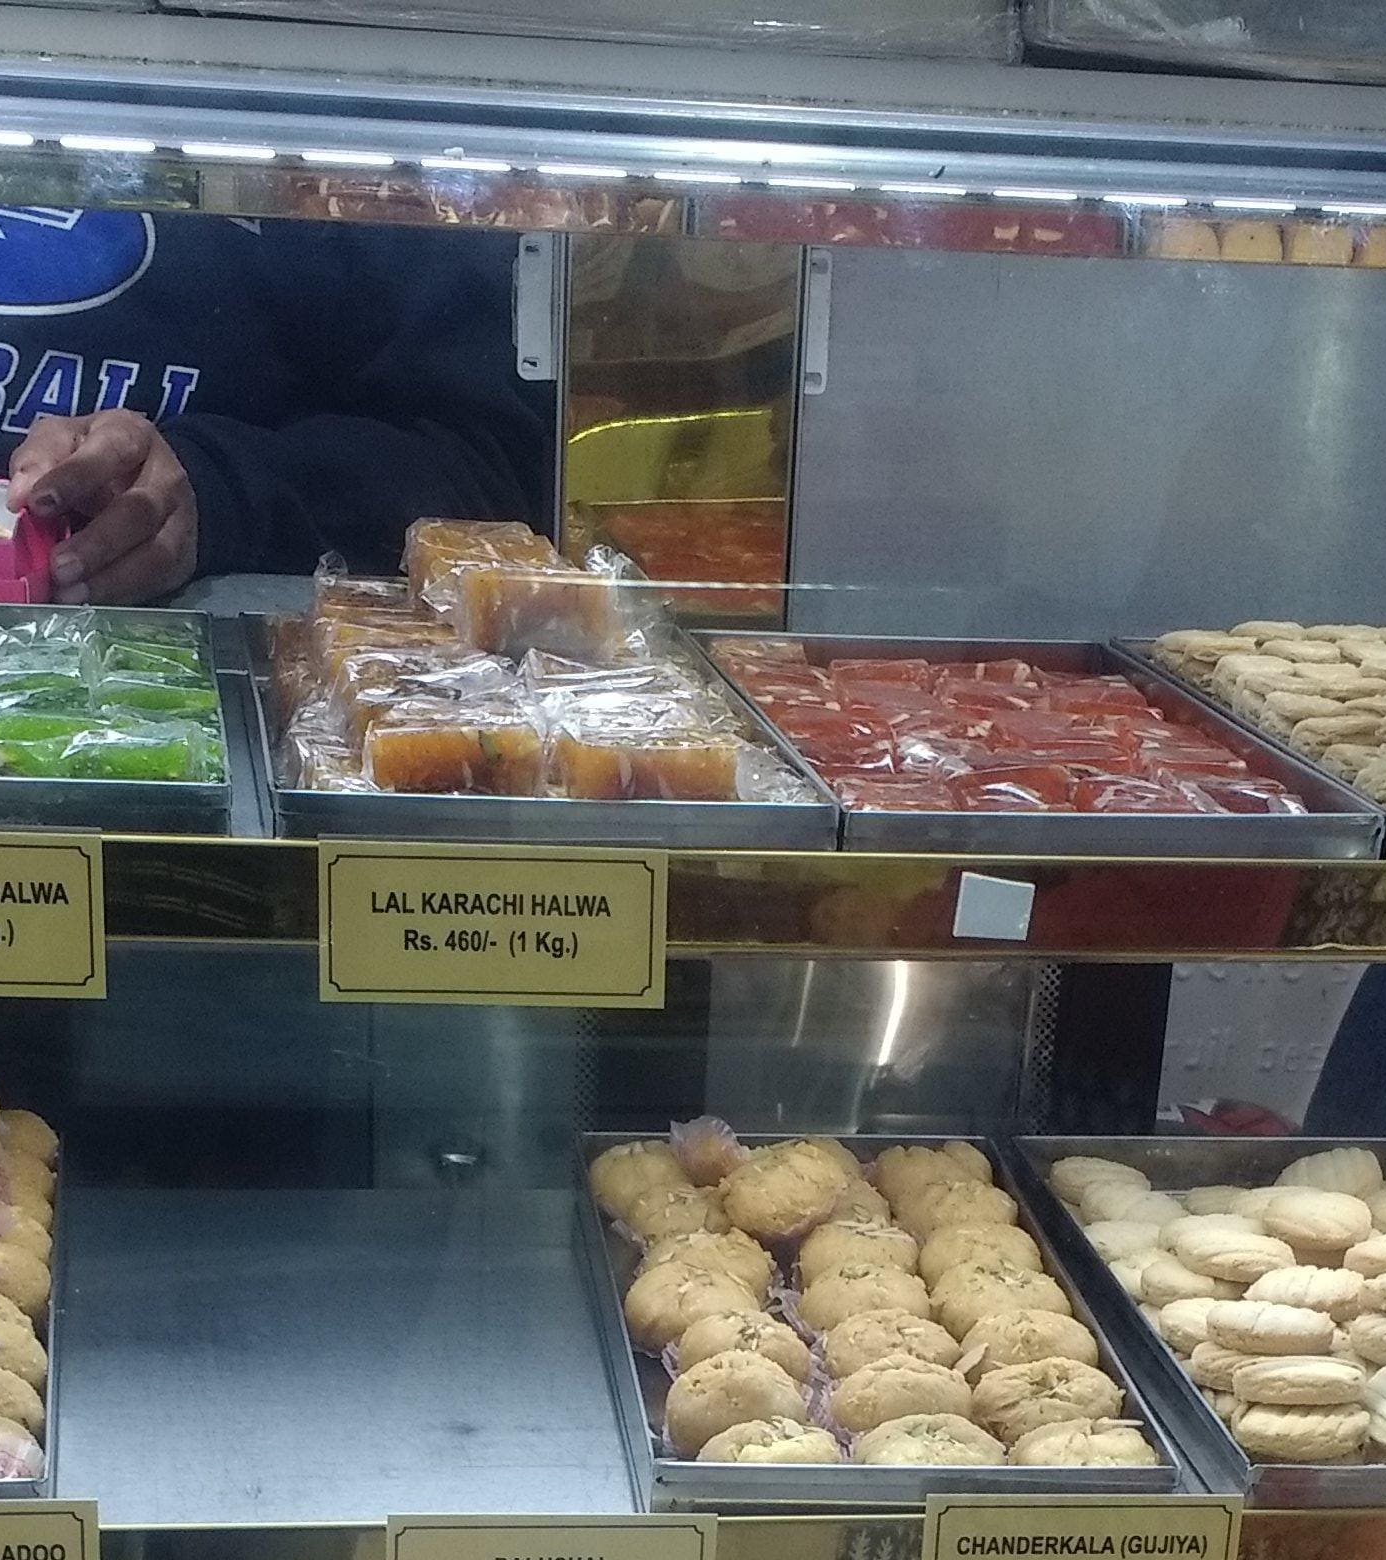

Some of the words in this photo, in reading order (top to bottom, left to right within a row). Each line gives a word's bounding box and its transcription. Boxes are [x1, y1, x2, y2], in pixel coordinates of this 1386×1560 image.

[372, 892, 414, 914] LAL
[422, 893, 524, 916] KARACHI
[532, 894, 611, 917] HALWA
[404, 930, 437, 950] Rs.
[445, 931, 497, 952] 460/-
[510, 932, 526, 957] (1
[536, 933, 578, 958] Kg.)
[957, 1536, 1114, 1555] CHANDERKALA
[1121, 1536, 1208, 1559] (GUJIYA)
